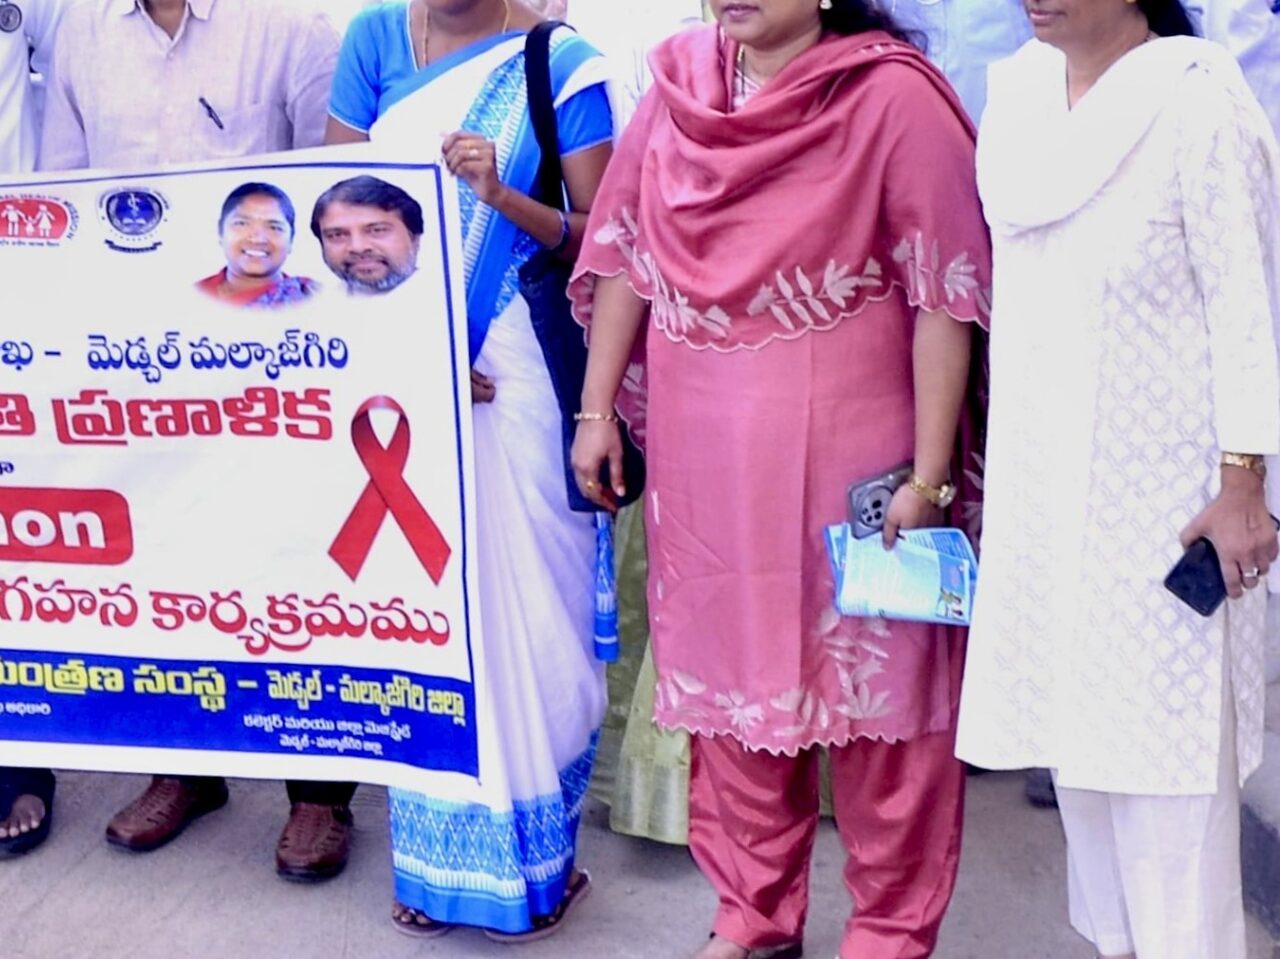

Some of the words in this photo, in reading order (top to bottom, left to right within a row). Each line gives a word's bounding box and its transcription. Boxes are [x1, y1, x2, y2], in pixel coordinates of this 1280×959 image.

[53, 386, 333, 446] ప్రణాళిక
[149, 590, 451, 656] కార్యక్రమము
[132, 663, 227, 712] సంస్థ
